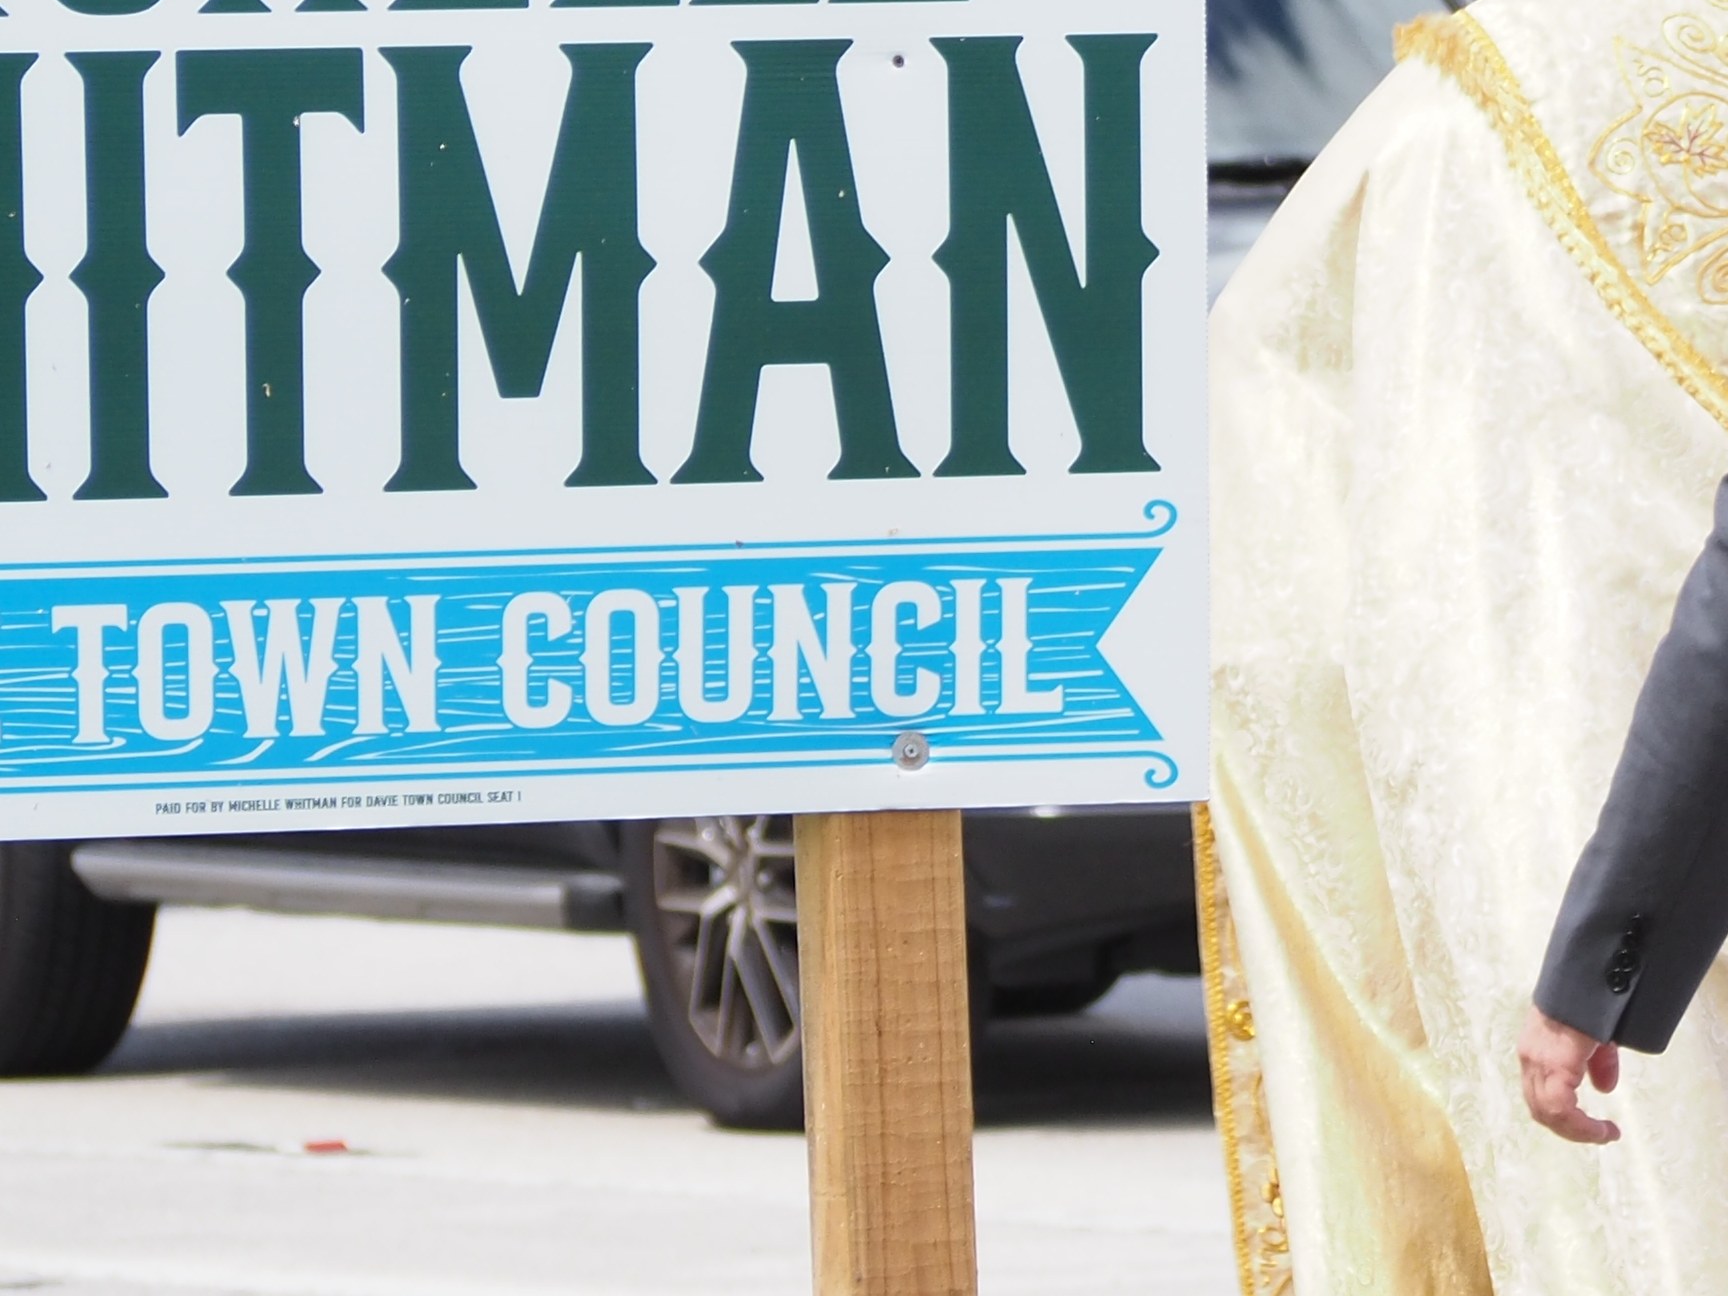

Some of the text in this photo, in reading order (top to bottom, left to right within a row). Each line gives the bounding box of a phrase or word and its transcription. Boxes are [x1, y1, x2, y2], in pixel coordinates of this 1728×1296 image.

[51, 577, 1065, 745] TOWN COUNCIL
[155, 802, 181, 814] PAID
[185, 801, 207, 813] FOR
[211, 800, 224, 813] BY
[228, 798, 281, 812] MICHELLE
[285, 797, 337, 811] WHITMAN
[341, 795, 362, 808] FOR
[366, 795, 398, 807] DAVIE
[402, 793, 434, 806] TOWN
[437, 792, 484, 805] COUNCIL
[487, 790, 514, 803] SEAT
